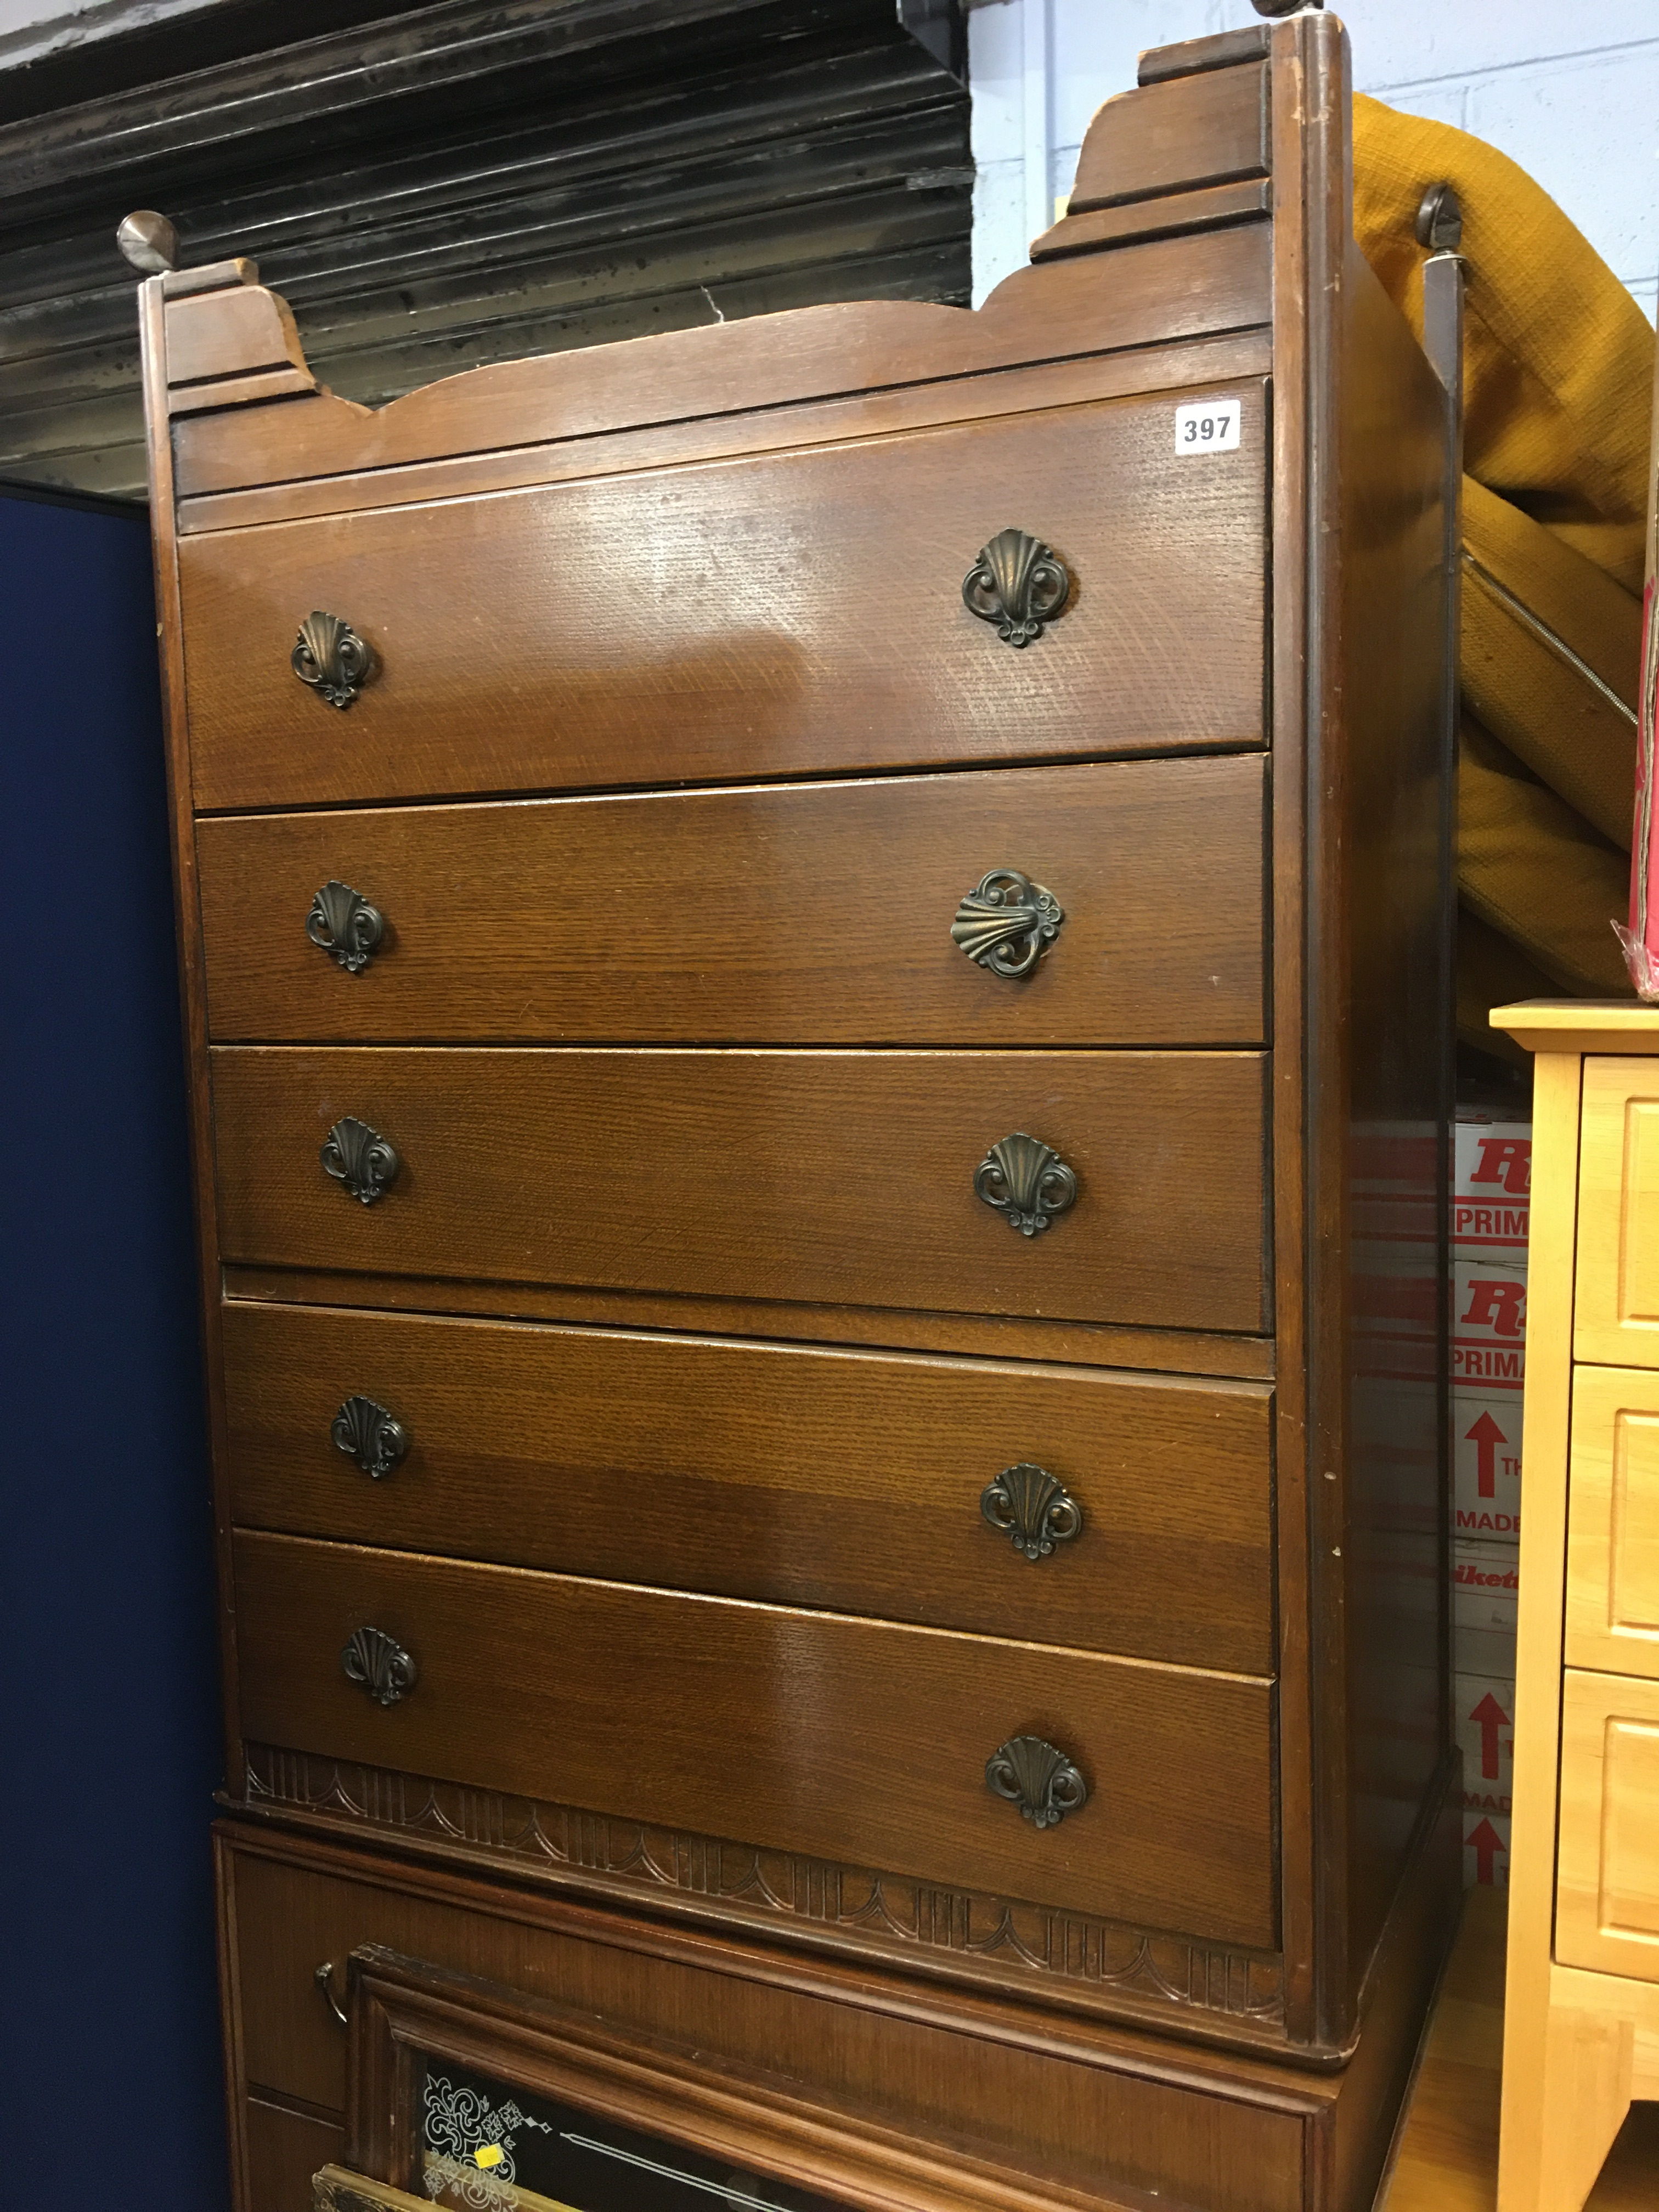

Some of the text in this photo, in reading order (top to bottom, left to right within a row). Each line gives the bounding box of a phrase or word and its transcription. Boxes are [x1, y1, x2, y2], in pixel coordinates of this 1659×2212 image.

[1184, 416, 1231, 442] 397
[1470, 1138, 1531, 1194] R
[1457, 1209, 1528, 1235] PRIM
[1460, 1280, 1526, 1336] R
[1454, 1349, 1525, 1378] PRIM
